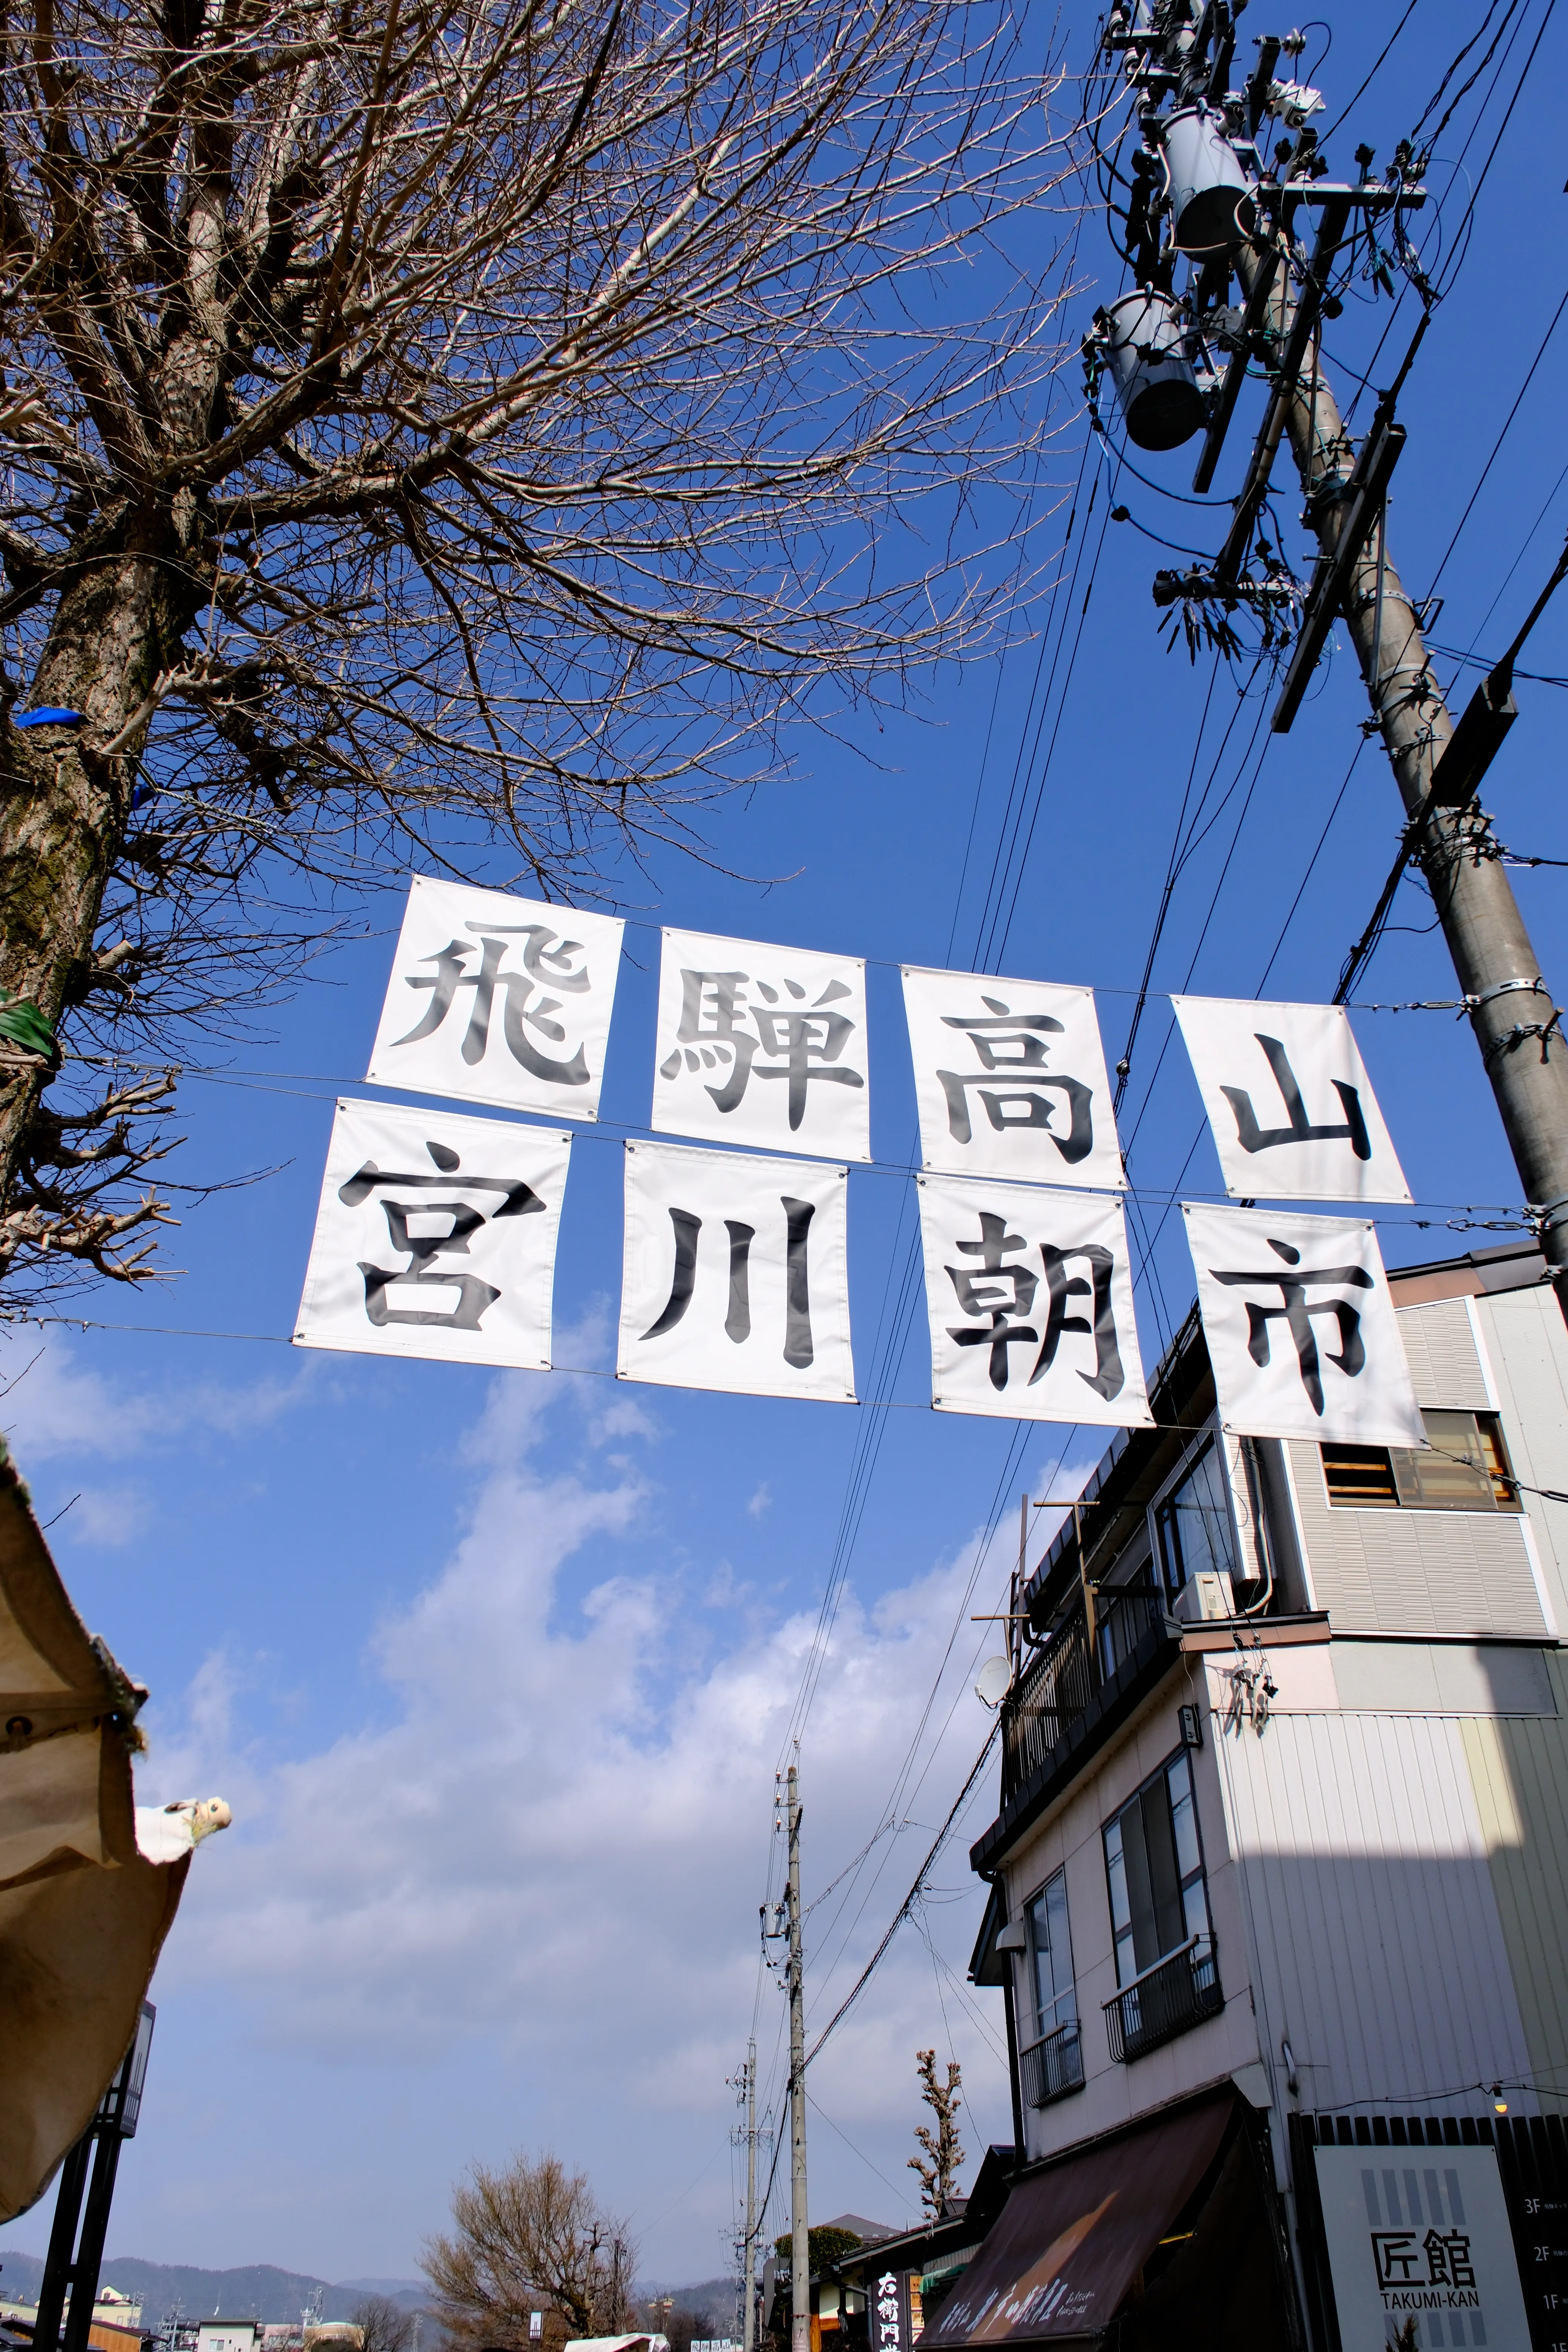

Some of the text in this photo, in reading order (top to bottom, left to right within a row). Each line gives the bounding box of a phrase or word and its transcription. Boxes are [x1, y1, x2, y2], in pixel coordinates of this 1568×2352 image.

[389, 921, 1371, 1165] 飛騨高山
[338, 1142, 1375, 1417] 宮川朝市
[1525, 2199, 1540, 2213] 3F
[1370, 2228, 1476, 2291] 匠館
[1534, 2246, 1549, 2261] 2F
[1380, 2291, 1479, 2309] TAKUMI-KAN
[1543, 2294, 1558, 2309] 1F
[1551, 2343, 1567, 2352] 1F
